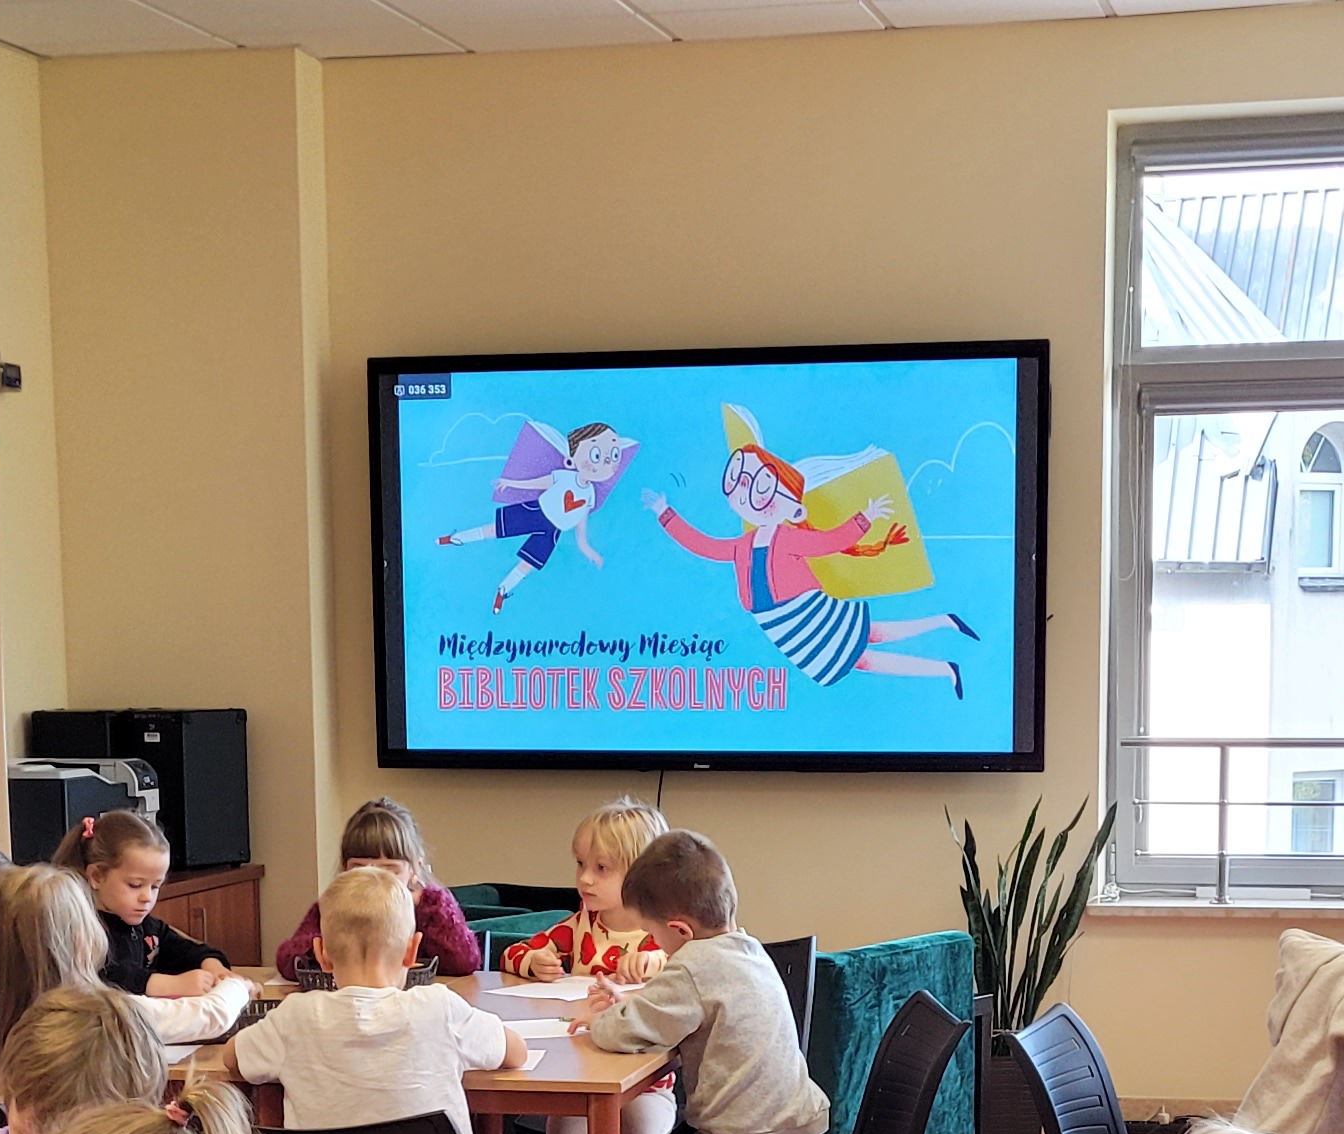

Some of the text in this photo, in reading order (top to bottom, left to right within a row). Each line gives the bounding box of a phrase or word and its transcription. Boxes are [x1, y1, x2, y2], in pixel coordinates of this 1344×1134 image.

[408, 384, 446, 395] 036 353
[439, 630, 728, 663] Międzynarodowy Miesiąc
[437, 665, 788, 711] BIBLIOTEK SZKOLNYCH
